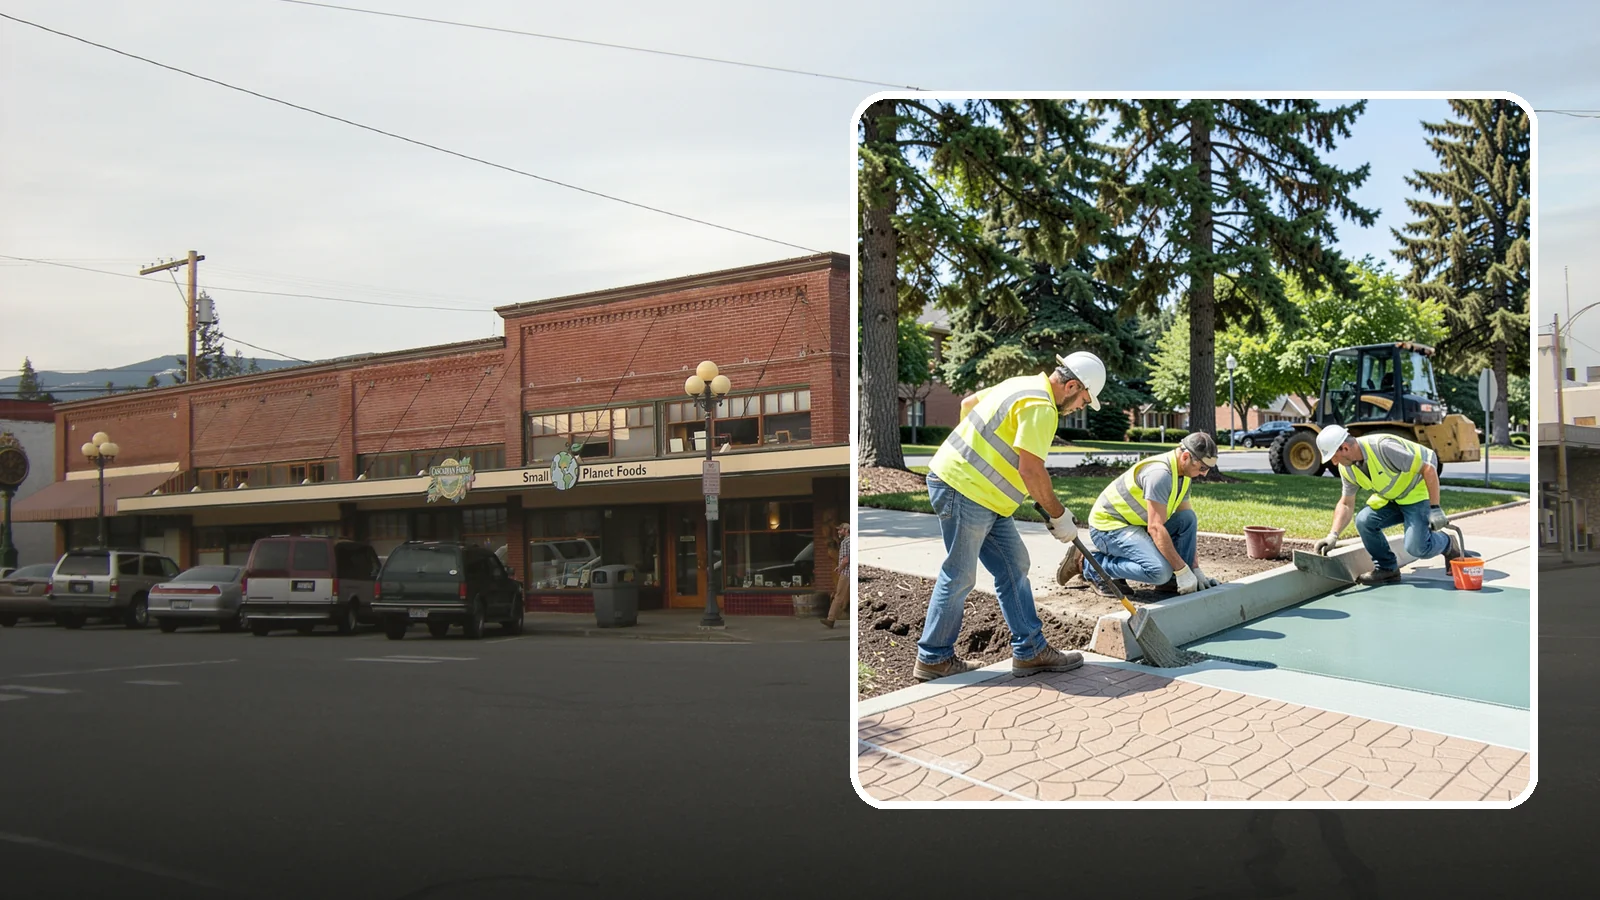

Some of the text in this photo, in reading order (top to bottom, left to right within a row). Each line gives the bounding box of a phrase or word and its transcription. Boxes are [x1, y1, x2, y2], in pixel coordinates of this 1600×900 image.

[523, 464, 647, 483] Small Planet Foods
